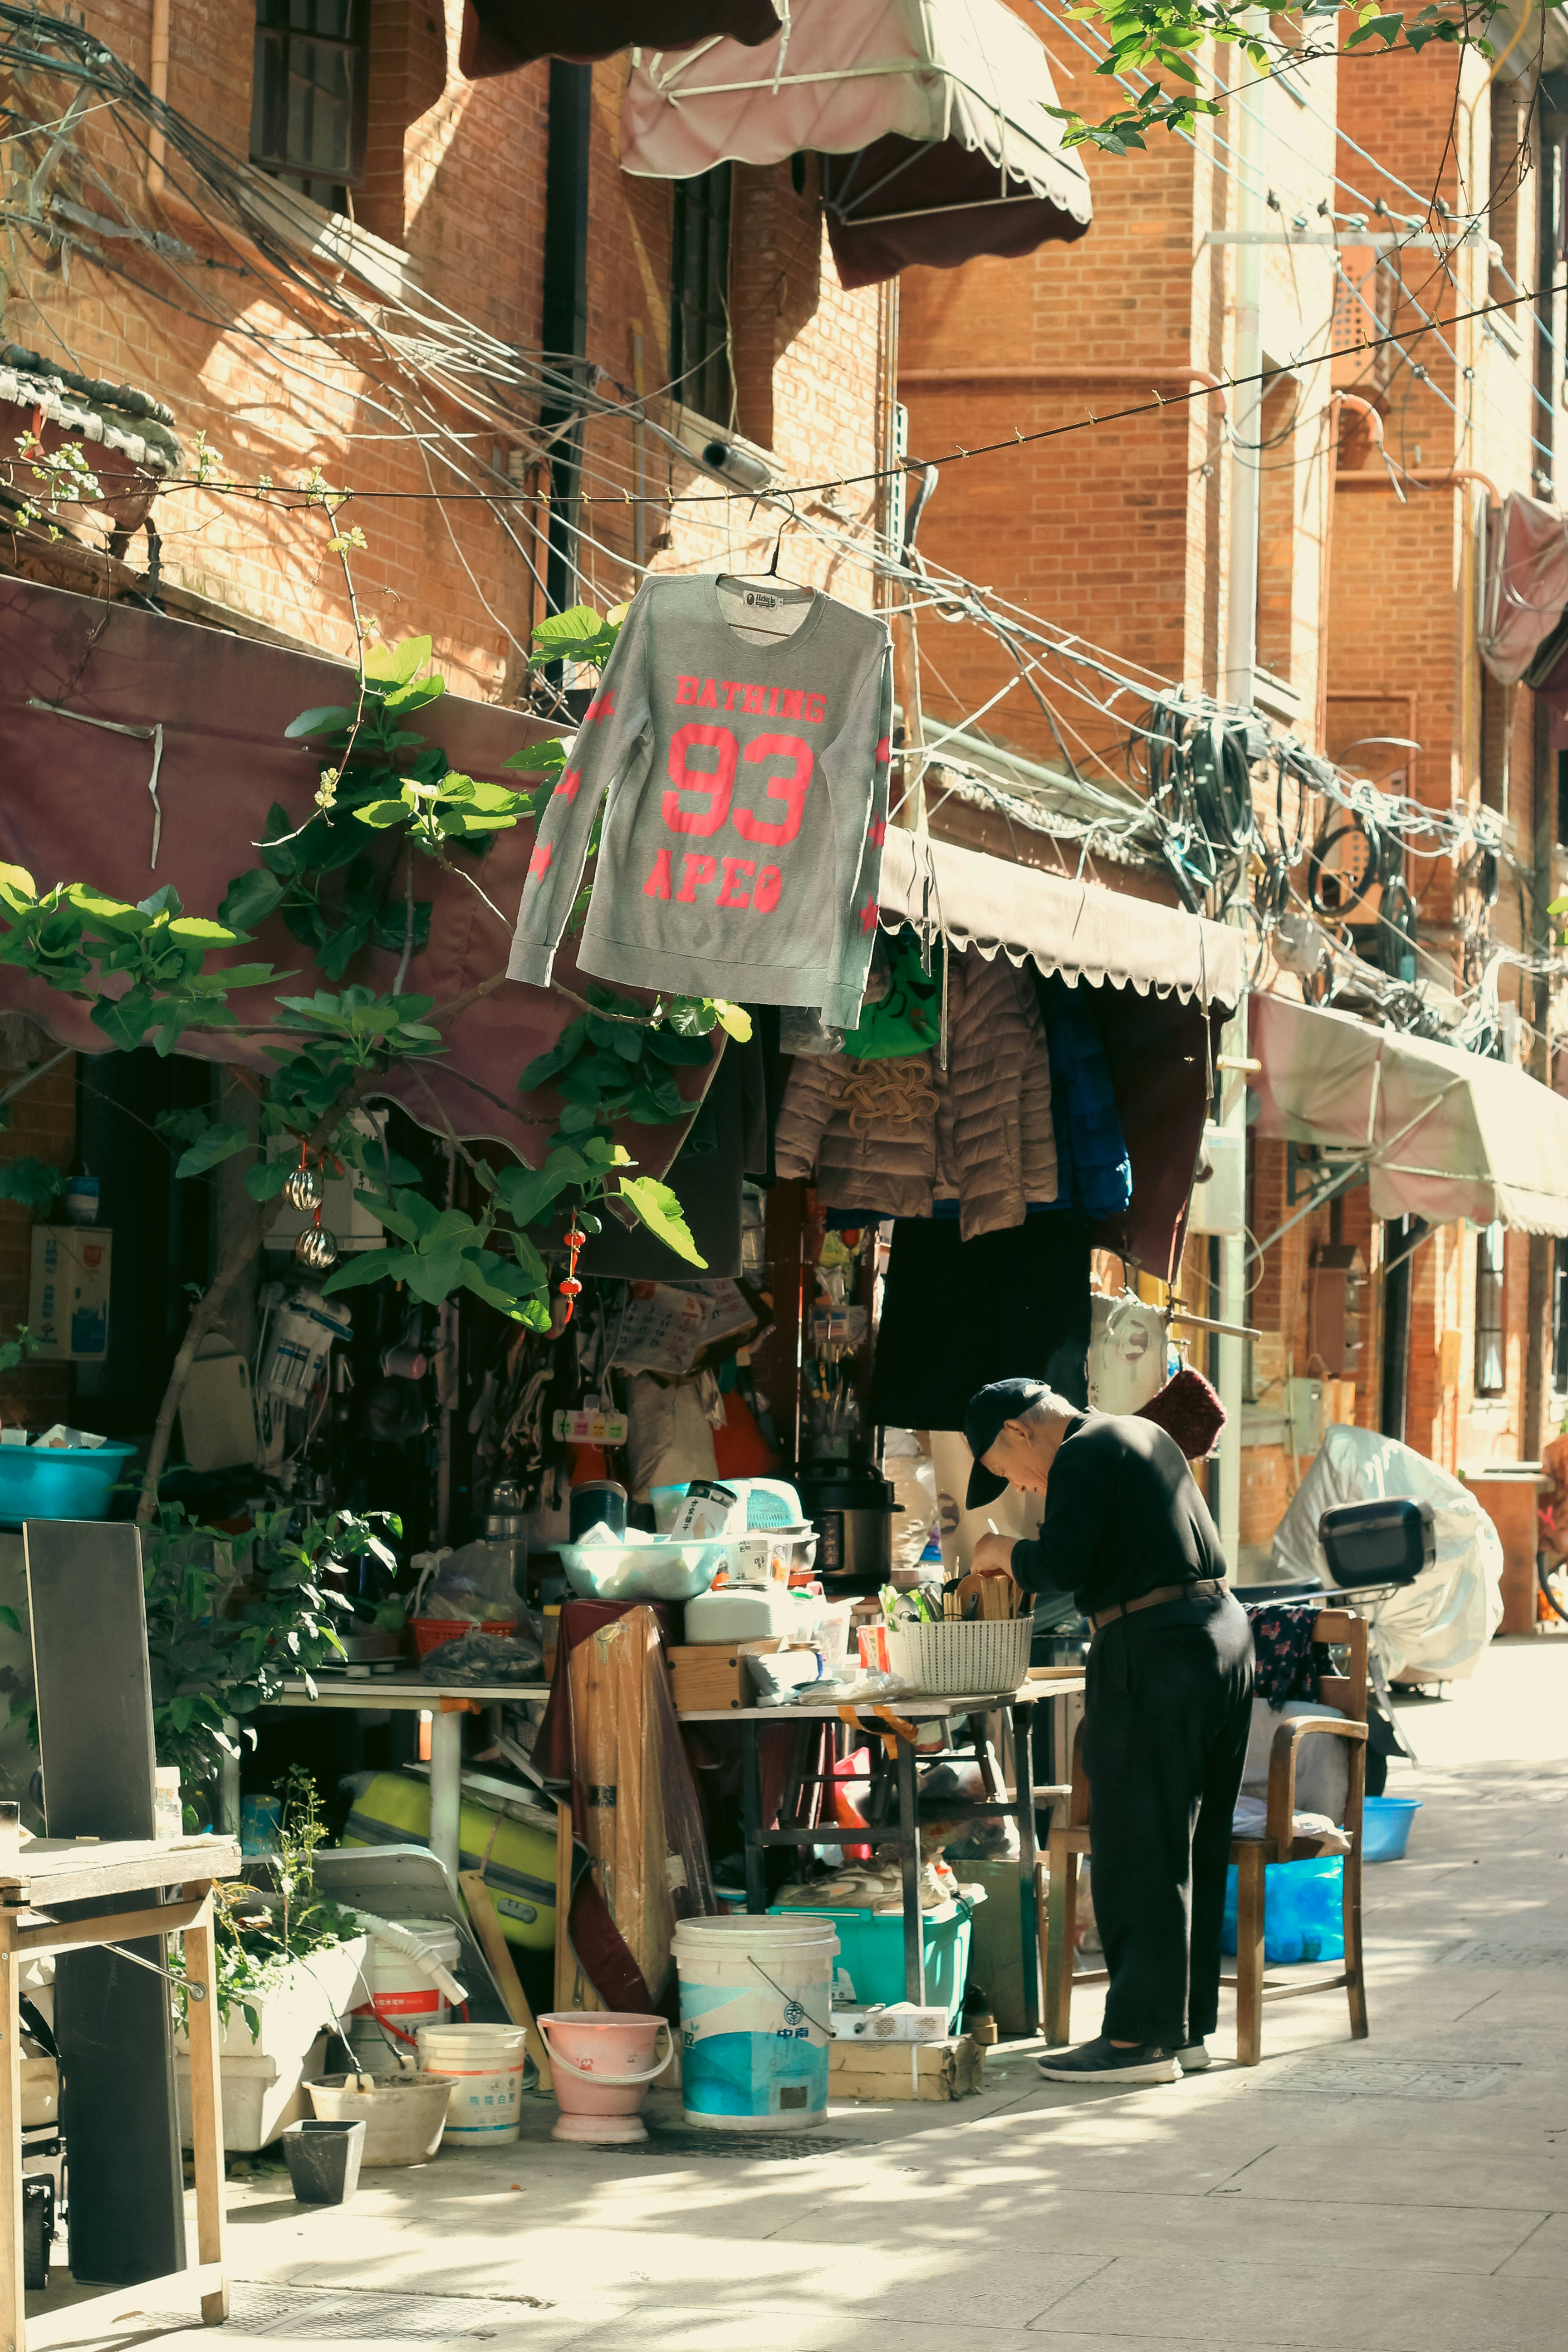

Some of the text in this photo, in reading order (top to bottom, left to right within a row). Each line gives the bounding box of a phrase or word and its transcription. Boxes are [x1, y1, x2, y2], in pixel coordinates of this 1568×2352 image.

[673, 675, 827, 724] BATHING
[661, 723, 814, 847] 93
[776, 2027, 809, 2039] 中南
